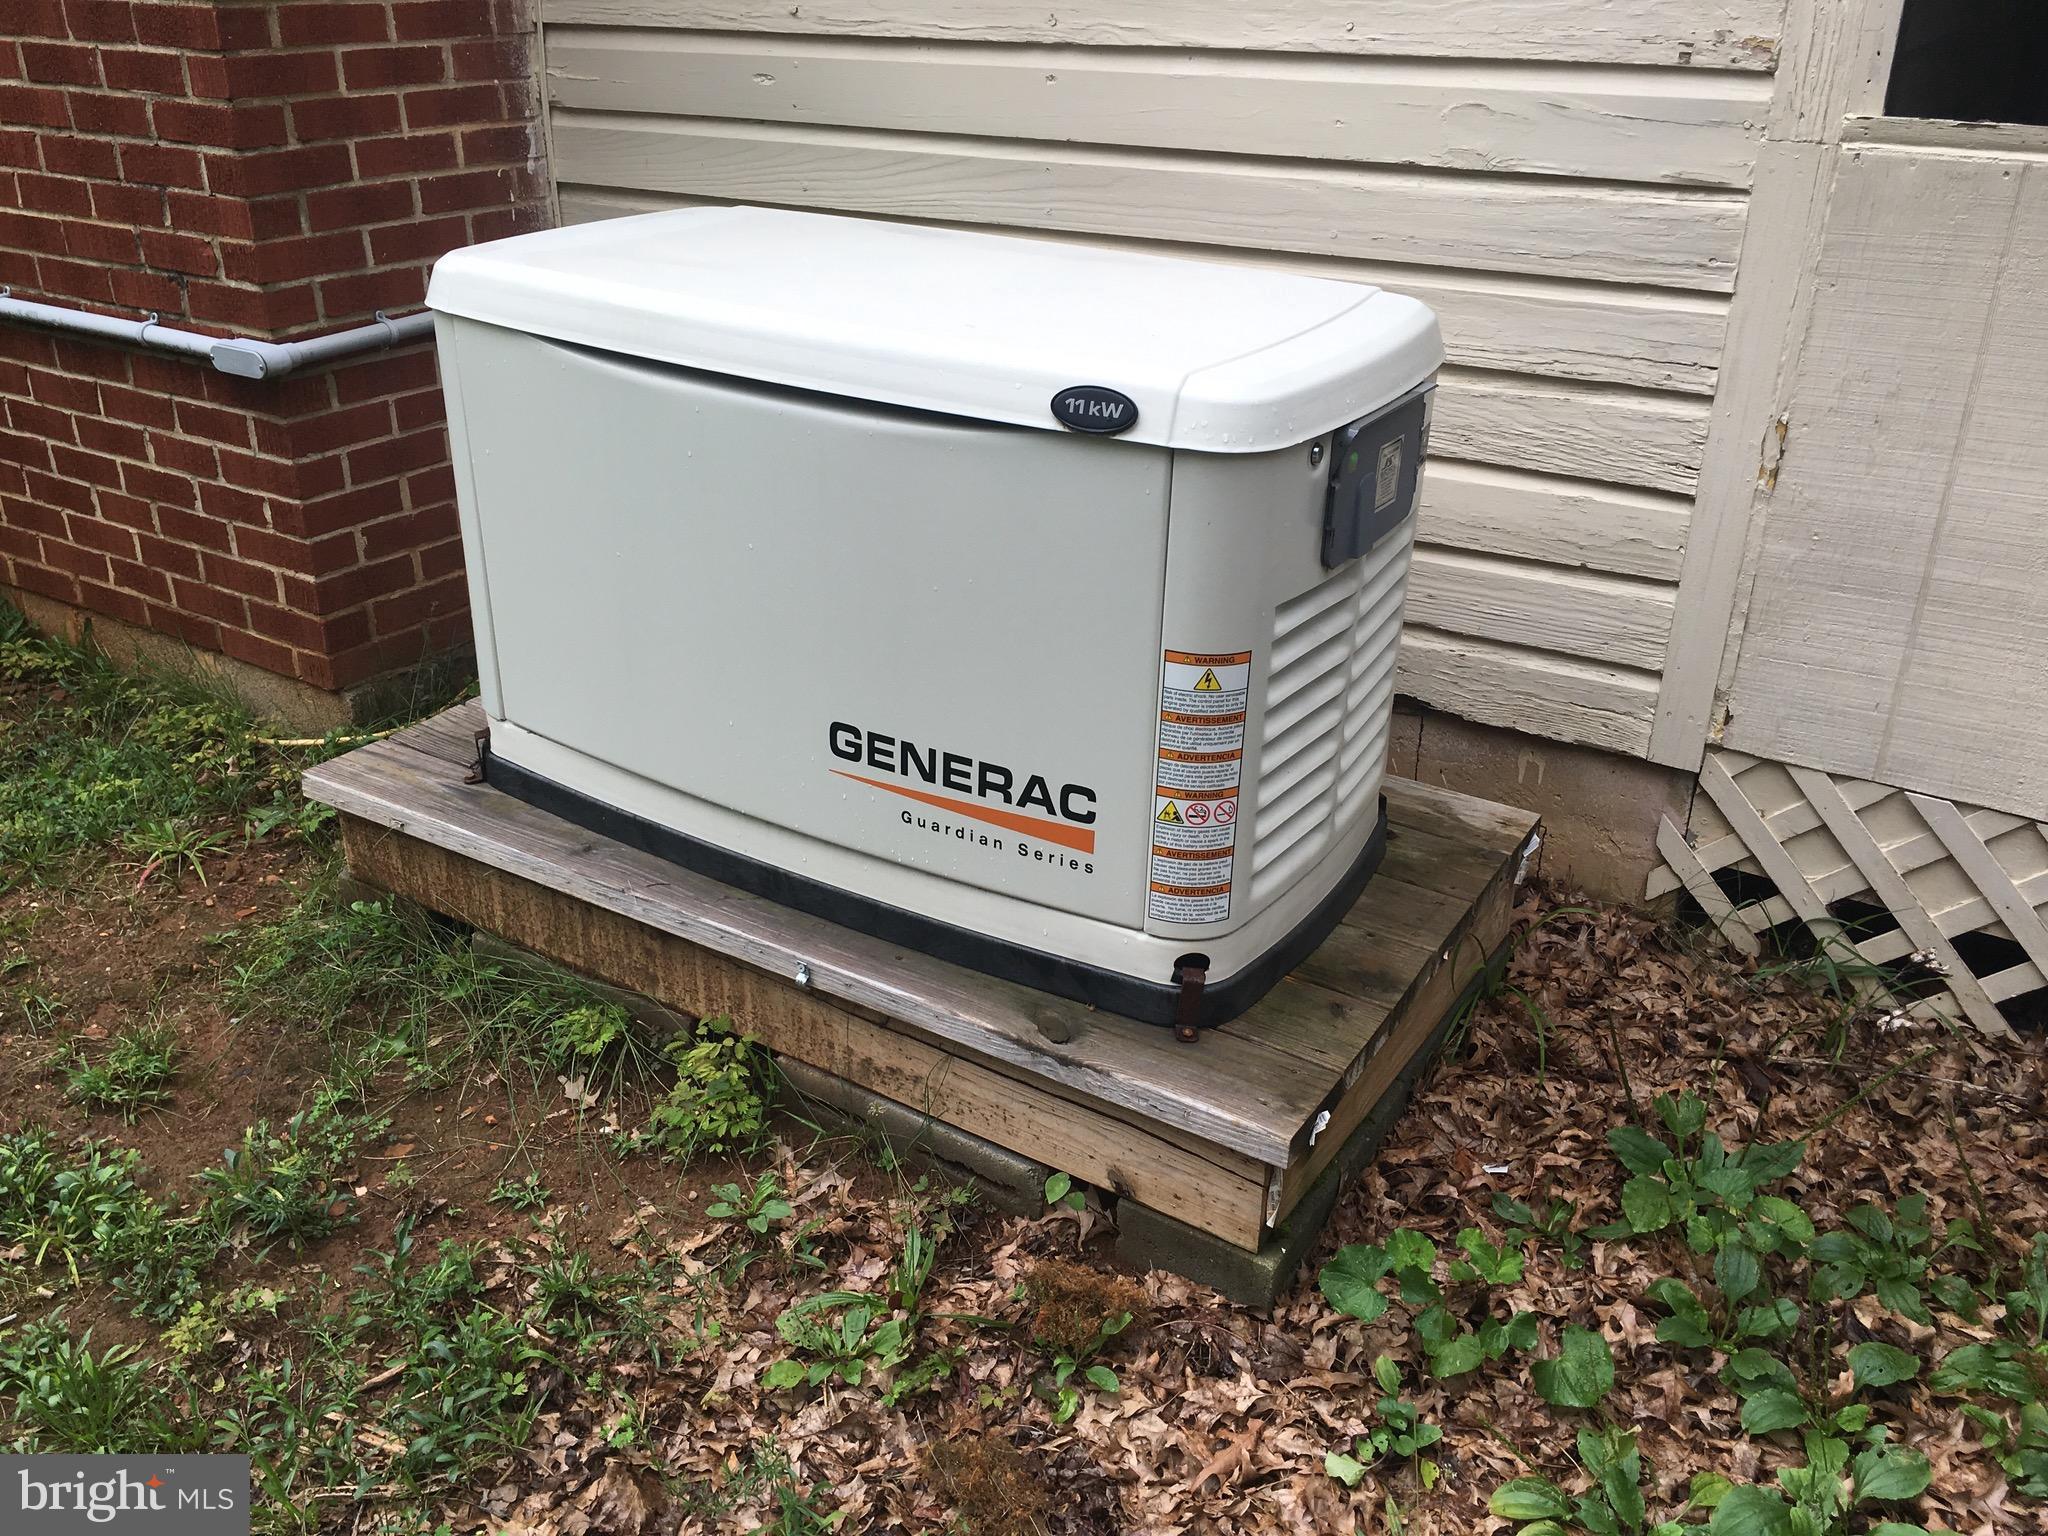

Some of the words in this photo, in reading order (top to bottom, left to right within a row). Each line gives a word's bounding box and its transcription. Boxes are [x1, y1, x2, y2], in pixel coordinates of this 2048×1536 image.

[1194, 656, 1235, 664] WARNING
[1175, 714, 1244, 724] AVERTISSEMENT
[1177, 752, 1235, 762] ADVERTENCIA
[829, 721, 1097, 825] GENERAC
[1185, 791, 1224, 799] WARNING
[901, 811, 1002, 850] Guardian
[1018, 843, 1094, 874] Series
[1166, 849, 1231, 859] AVERTISSEMENT
[1168, 886, 1224, 896] ADVERTENCIA
